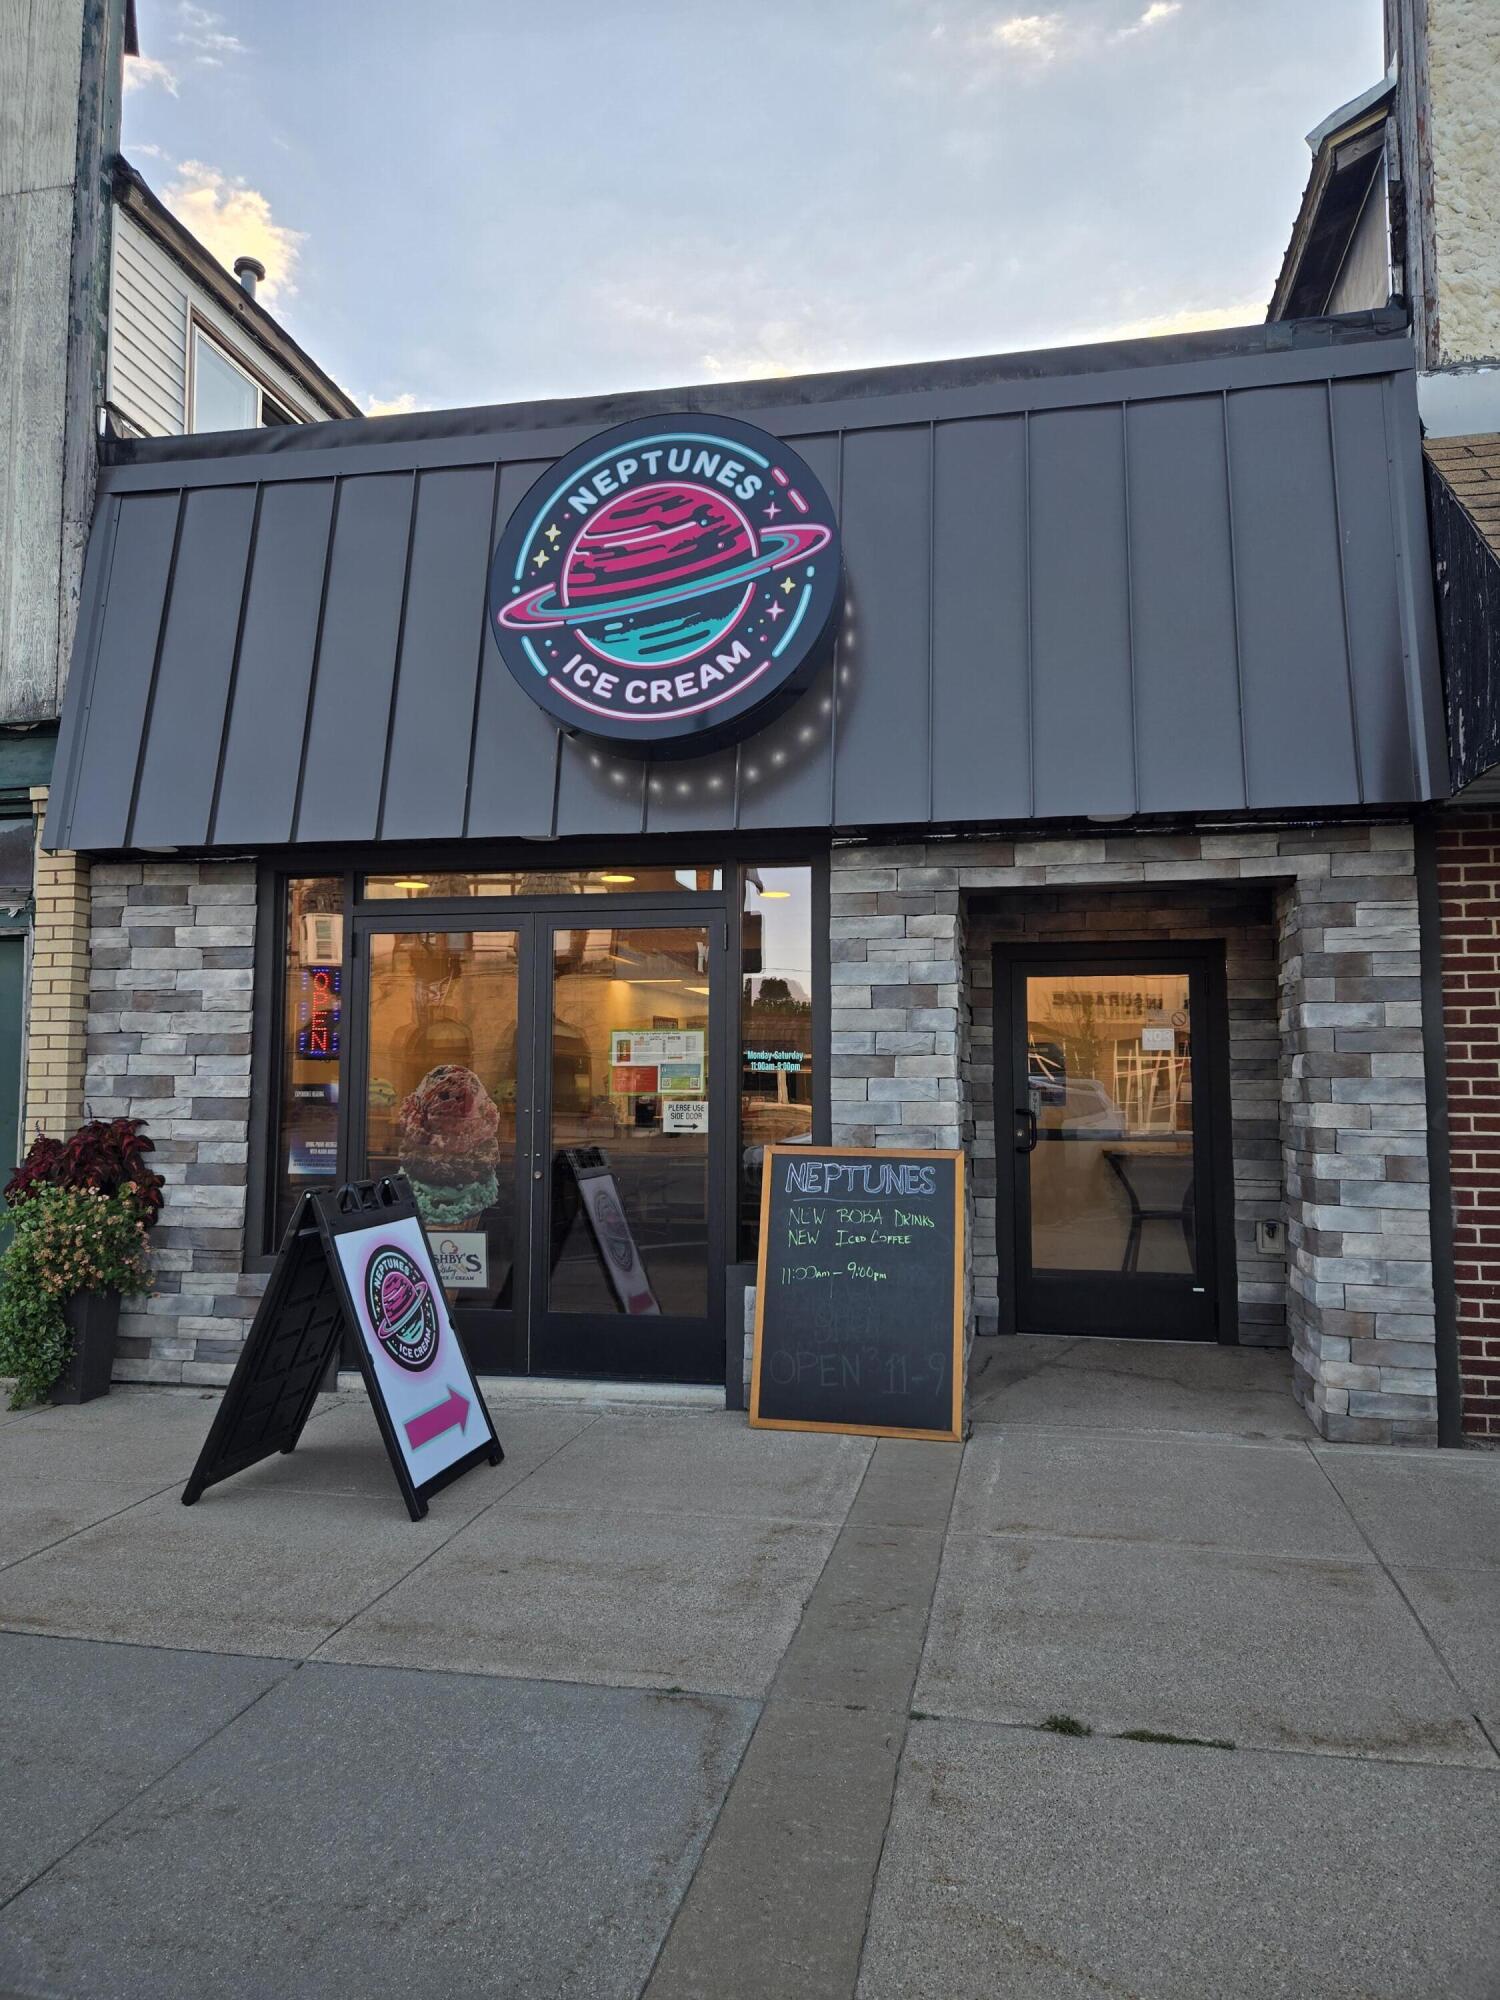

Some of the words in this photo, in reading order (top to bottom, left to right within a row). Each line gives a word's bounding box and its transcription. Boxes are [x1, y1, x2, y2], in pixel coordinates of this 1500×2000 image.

[567, 448, 763, 515] NEPTUNES
[562, 654, 620, 699] ICE
[625, 640, 751, 705] CREAM
[311, 972, 329, 1051] OPEN
[668, 1104, 690, 1112] PLEASE
[692, 1104, 705, 1112] USE
[670, 1112, 685, 1120] SIDE
[785, 1162, 936, 1195] NEPTUNES
[788, 1206, 826, 1227] NEW
[836, 1208, 883, 1225] BOBA
[788, 1230, 820, 1249] NEW
[373, 1258, 410, 1290] NEPTUNES
[399, 1343, 414, 1359] ICE
[414, 1327, 432, 1359] CREAM
